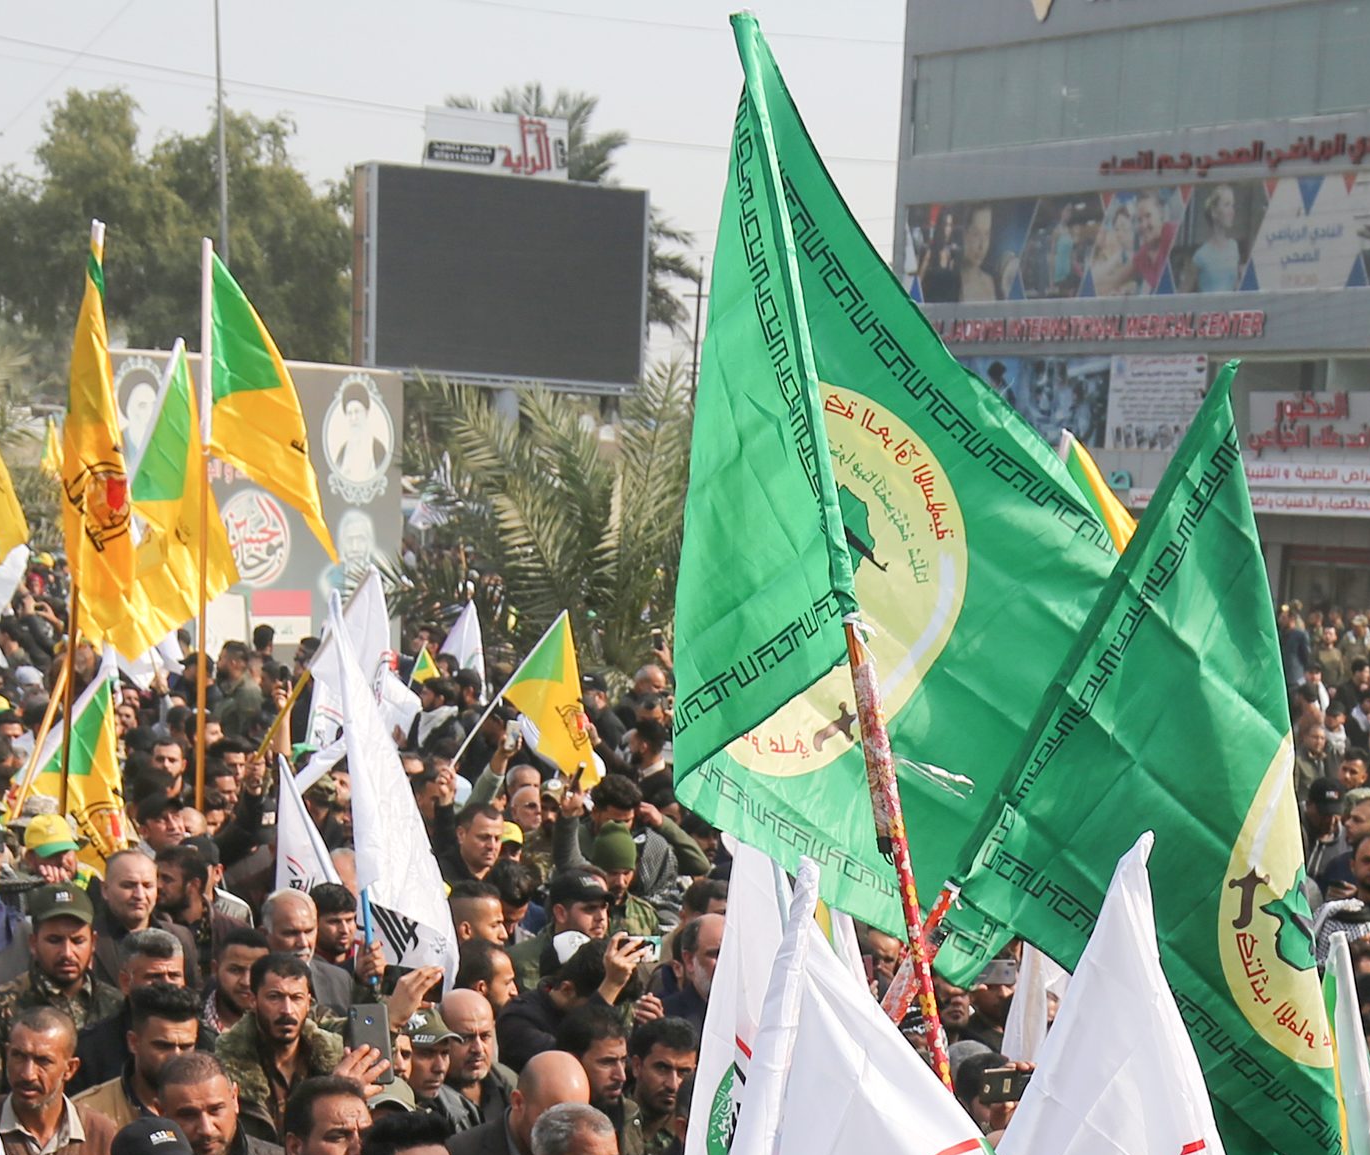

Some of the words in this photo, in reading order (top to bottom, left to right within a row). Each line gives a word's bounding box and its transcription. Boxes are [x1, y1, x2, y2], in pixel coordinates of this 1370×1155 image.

[1007, 315, 1123, 341] INTERNATIONAL
[1126, 312, 1195, 338] MEDICAL
[1197, 310, 1266, 337] CENTER
